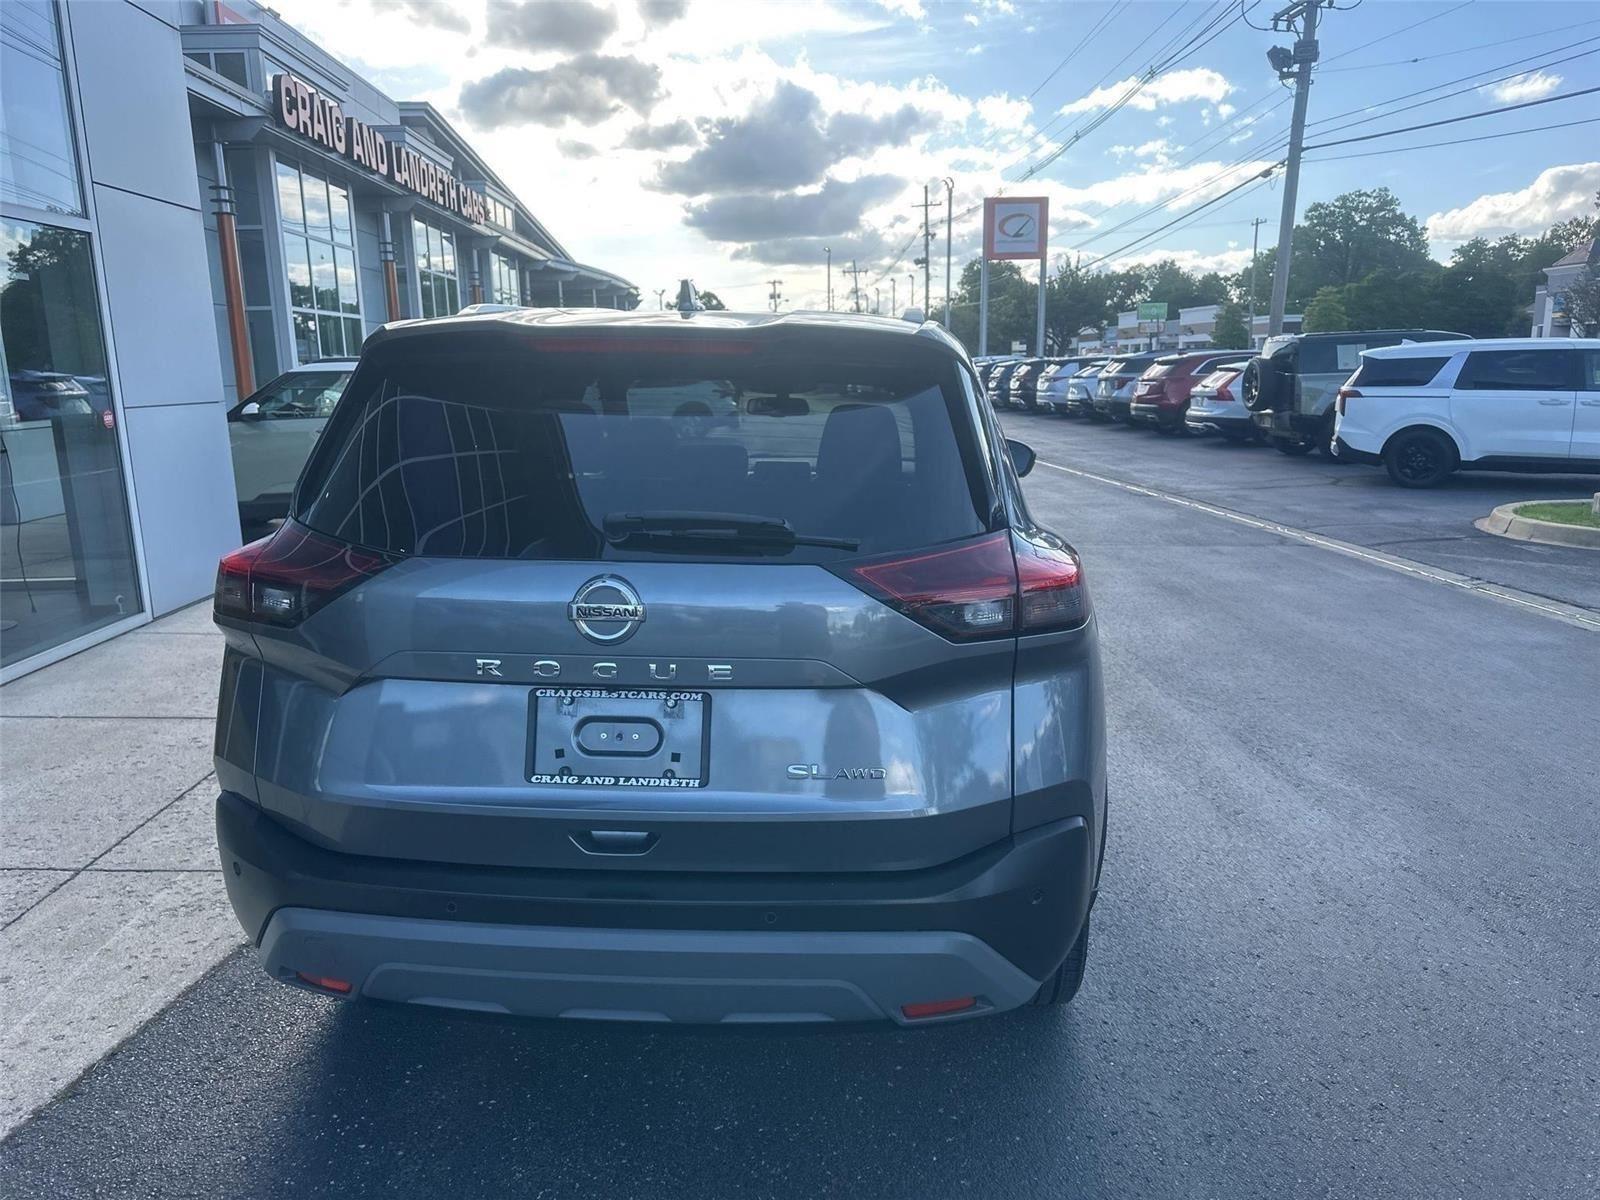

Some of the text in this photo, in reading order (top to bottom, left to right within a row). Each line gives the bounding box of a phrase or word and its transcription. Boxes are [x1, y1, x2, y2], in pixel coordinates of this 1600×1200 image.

[276, 73, 486, 225] CRAIG AND LANDRETH CARS
[575, 605, 638, 619] NISSAN
[475, 658, 736, 681] ROGUE
[535, 688, 704, 701] CRAIGSBESTCARS.COM
[787, 763, 887, 780] SL AWD
[530, 774, 701, 788] CRAIG AND LANDRETH
